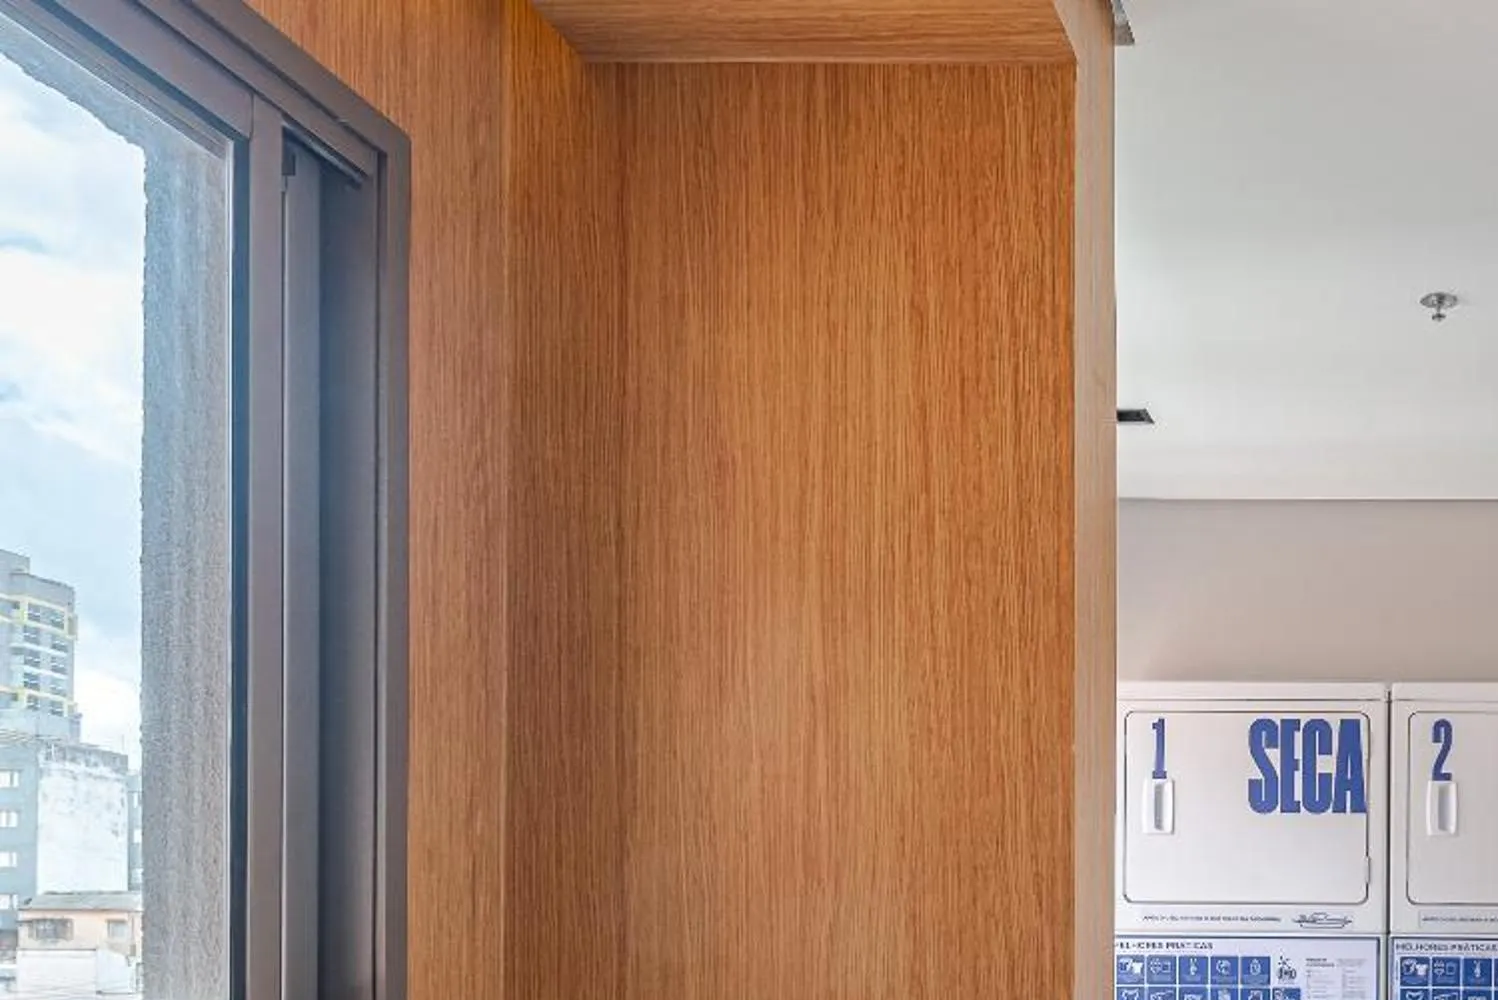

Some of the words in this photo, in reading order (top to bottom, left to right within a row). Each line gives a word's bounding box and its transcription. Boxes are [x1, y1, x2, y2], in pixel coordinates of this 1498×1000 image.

[1151, 718, 1167, 778] 1
[1248, 719, 1367, 814] SECA
[1432, 718, 1453, 781] 2
